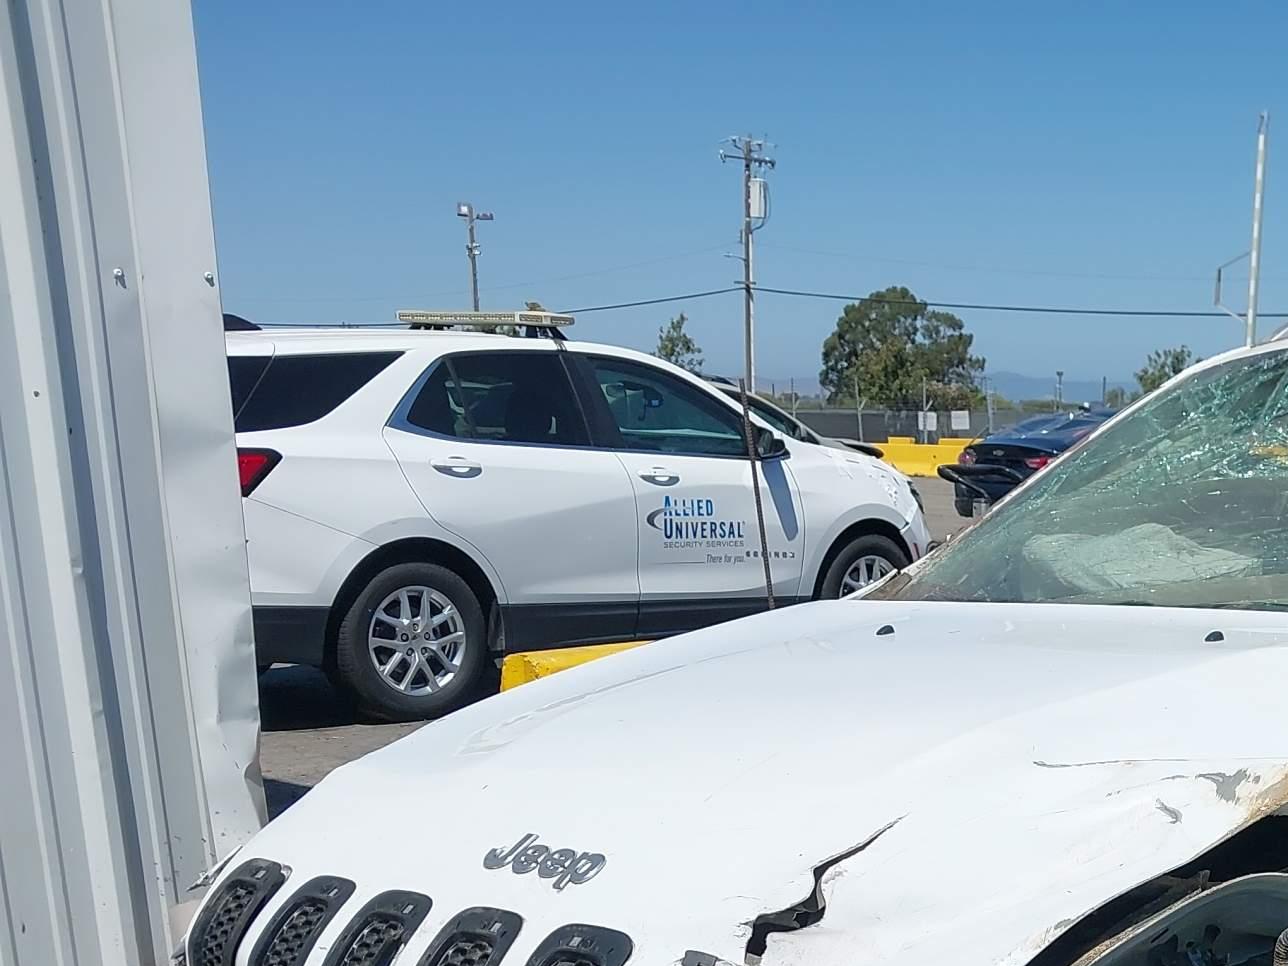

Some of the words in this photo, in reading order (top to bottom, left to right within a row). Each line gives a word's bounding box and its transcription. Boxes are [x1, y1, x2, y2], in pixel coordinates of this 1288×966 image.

[663, 495, 714, 517] ALLIED
[663, 518, 745, 539] UNIVERSAL
[663, 540, 703, 549] SECURITY
[706, 540, 745, 548] SERVICES
[706, 553, 722, 564] There
[483, 833, 607, 890] Jeep
